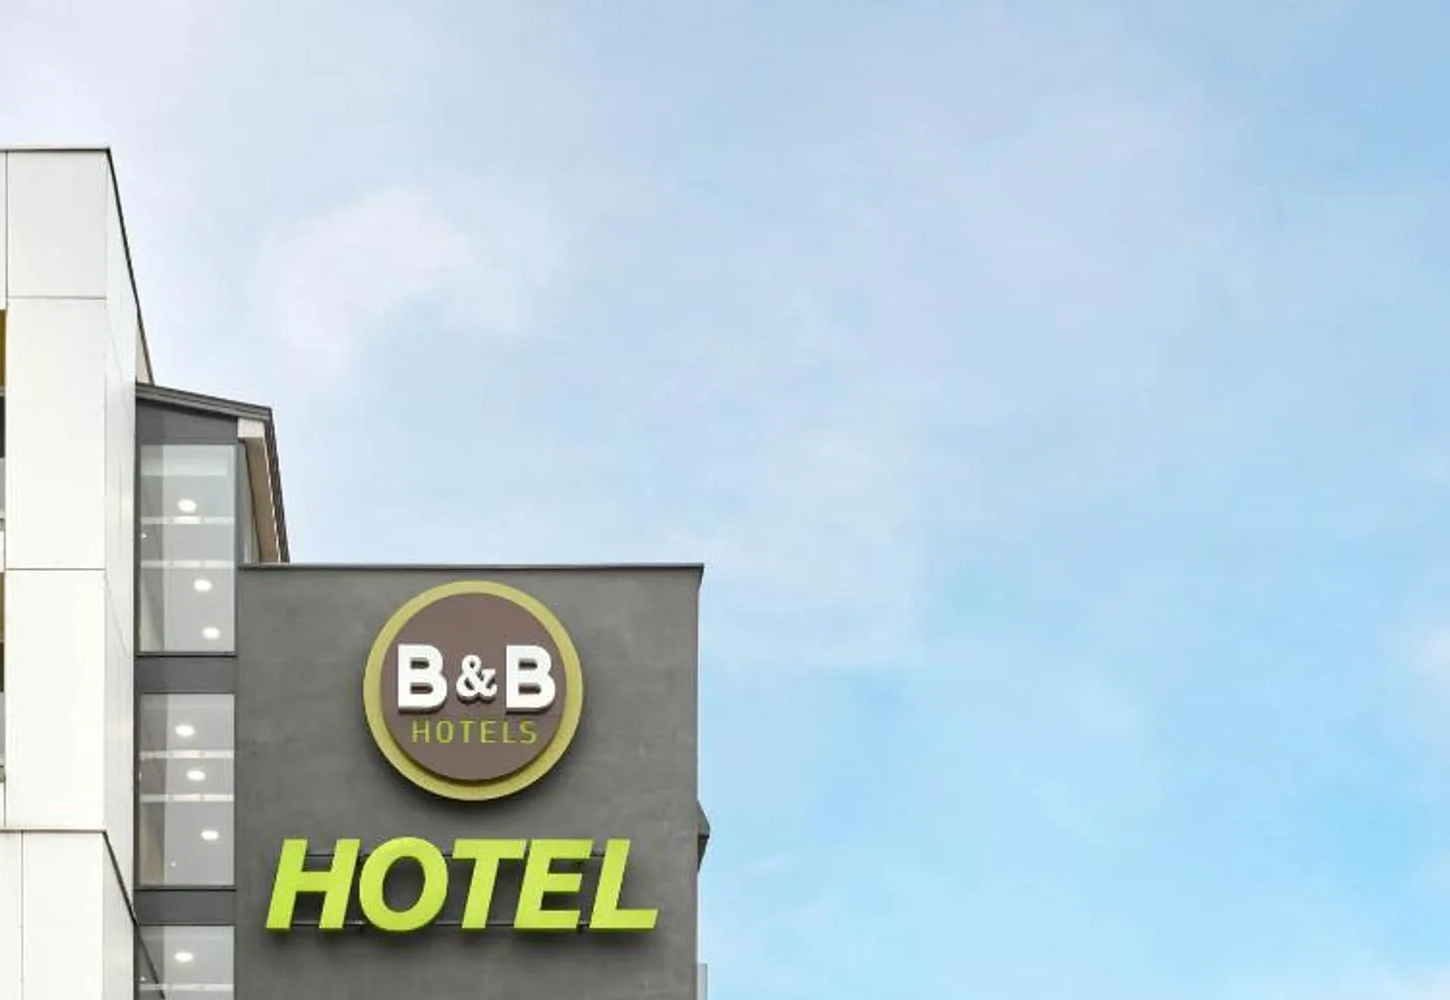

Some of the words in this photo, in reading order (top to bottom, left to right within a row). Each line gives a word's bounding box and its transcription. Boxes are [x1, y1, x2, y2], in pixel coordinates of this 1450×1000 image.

[397, 643, 556, 712] B&B
[411, 720, 539, 745] HOTELS
[265, 836, 660, 932] HOTEL
